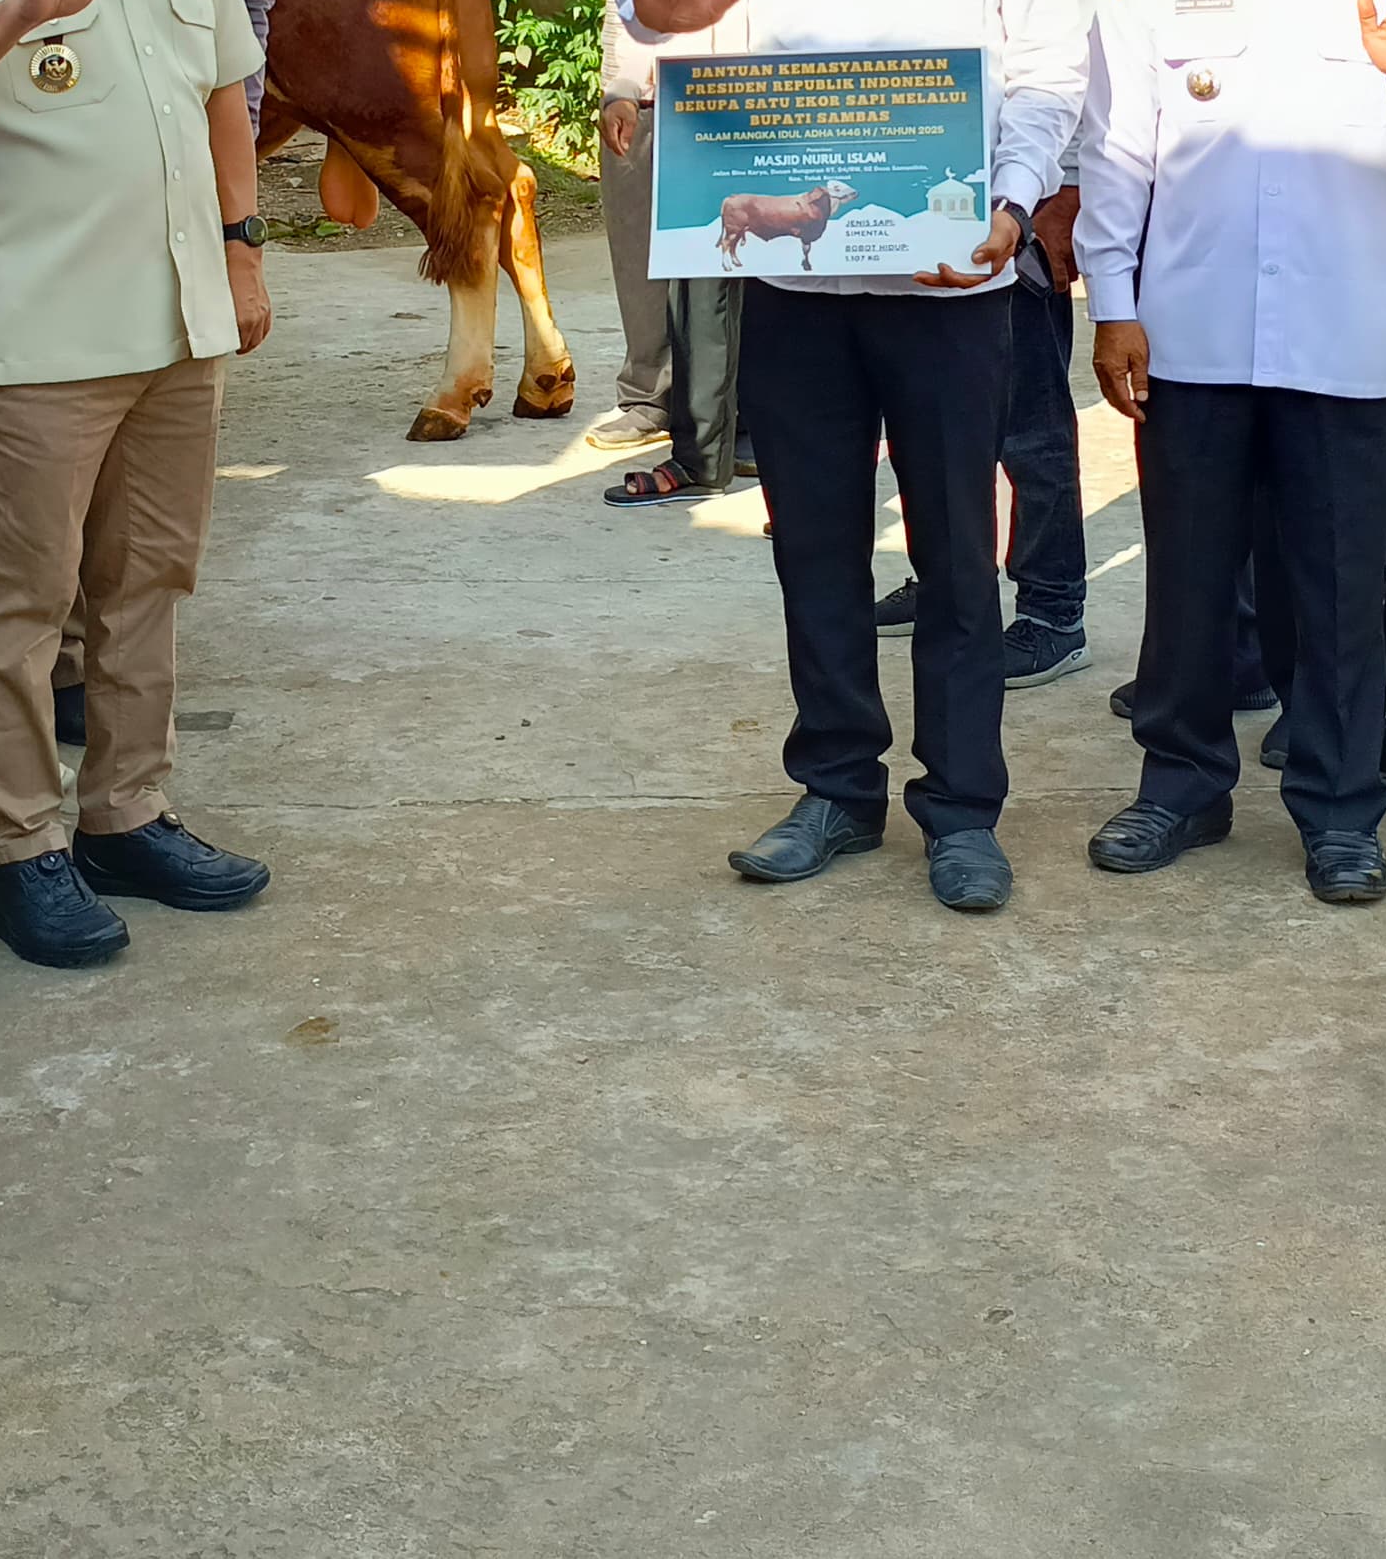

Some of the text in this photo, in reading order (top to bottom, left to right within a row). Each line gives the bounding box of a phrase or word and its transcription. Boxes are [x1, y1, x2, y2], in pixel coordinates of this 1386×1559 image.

[692, 58, 949, 78] BANTUAN KEMASYARAKATAN
[685, 75, 955, 95] PRESIDEN REPUBLIK INDONESIA
[674, 91, 968, 112] BERUPA SATU EKOR SAPI MELALUI
[750, 110, 891, 127] BUPATI SAMBAS
[695, 131, 732, 142] DALAM
[733, 130, 776, 141] RANGKA
[778, 130, 802, 139] IDUL
[804, 128, 834, 139] ADHA
[836, 127, 861, 137] 1446
[863, 127, 872, 137] H
[880, 126, 917, 136] TAHUN
[918, 125, 945, 135] 2025
[753, 151, 887, 166] MASJID NURUL ISLAM
[845, 219, 870, 227] JENIS
[845, 229, 889, 237] SIMENTAL
[845, 244, 876, 252] BOBOT
